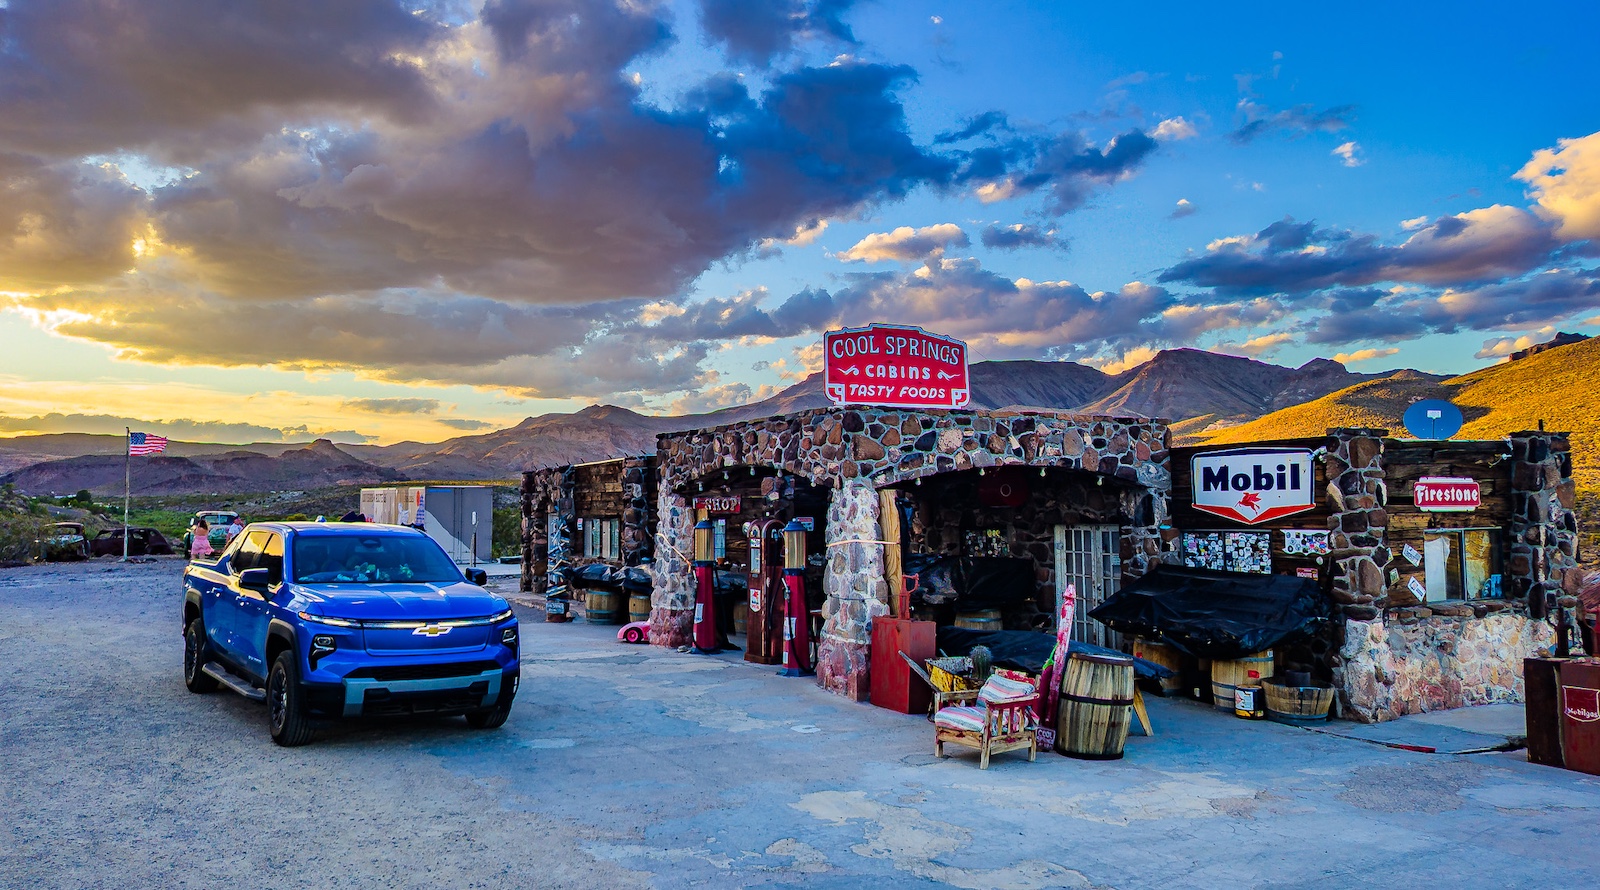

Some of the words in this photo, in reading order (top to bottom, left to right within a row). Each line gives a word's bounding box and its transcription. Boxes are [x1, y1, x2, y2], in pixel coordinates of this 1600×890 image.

[832, 335, 880, 359] COOL
[885, 336, 960, 365] SPRINGS
[865, 364, 931, 380] CABINS
[849, 384, 895, 398] TASTY
[899, 386, 946, 399] FOODS
[1202, 463, 1301, 491] Mobil
[1415, 485, 1479, 504] Firestone
[705, 497, 737, 511] SHOP
